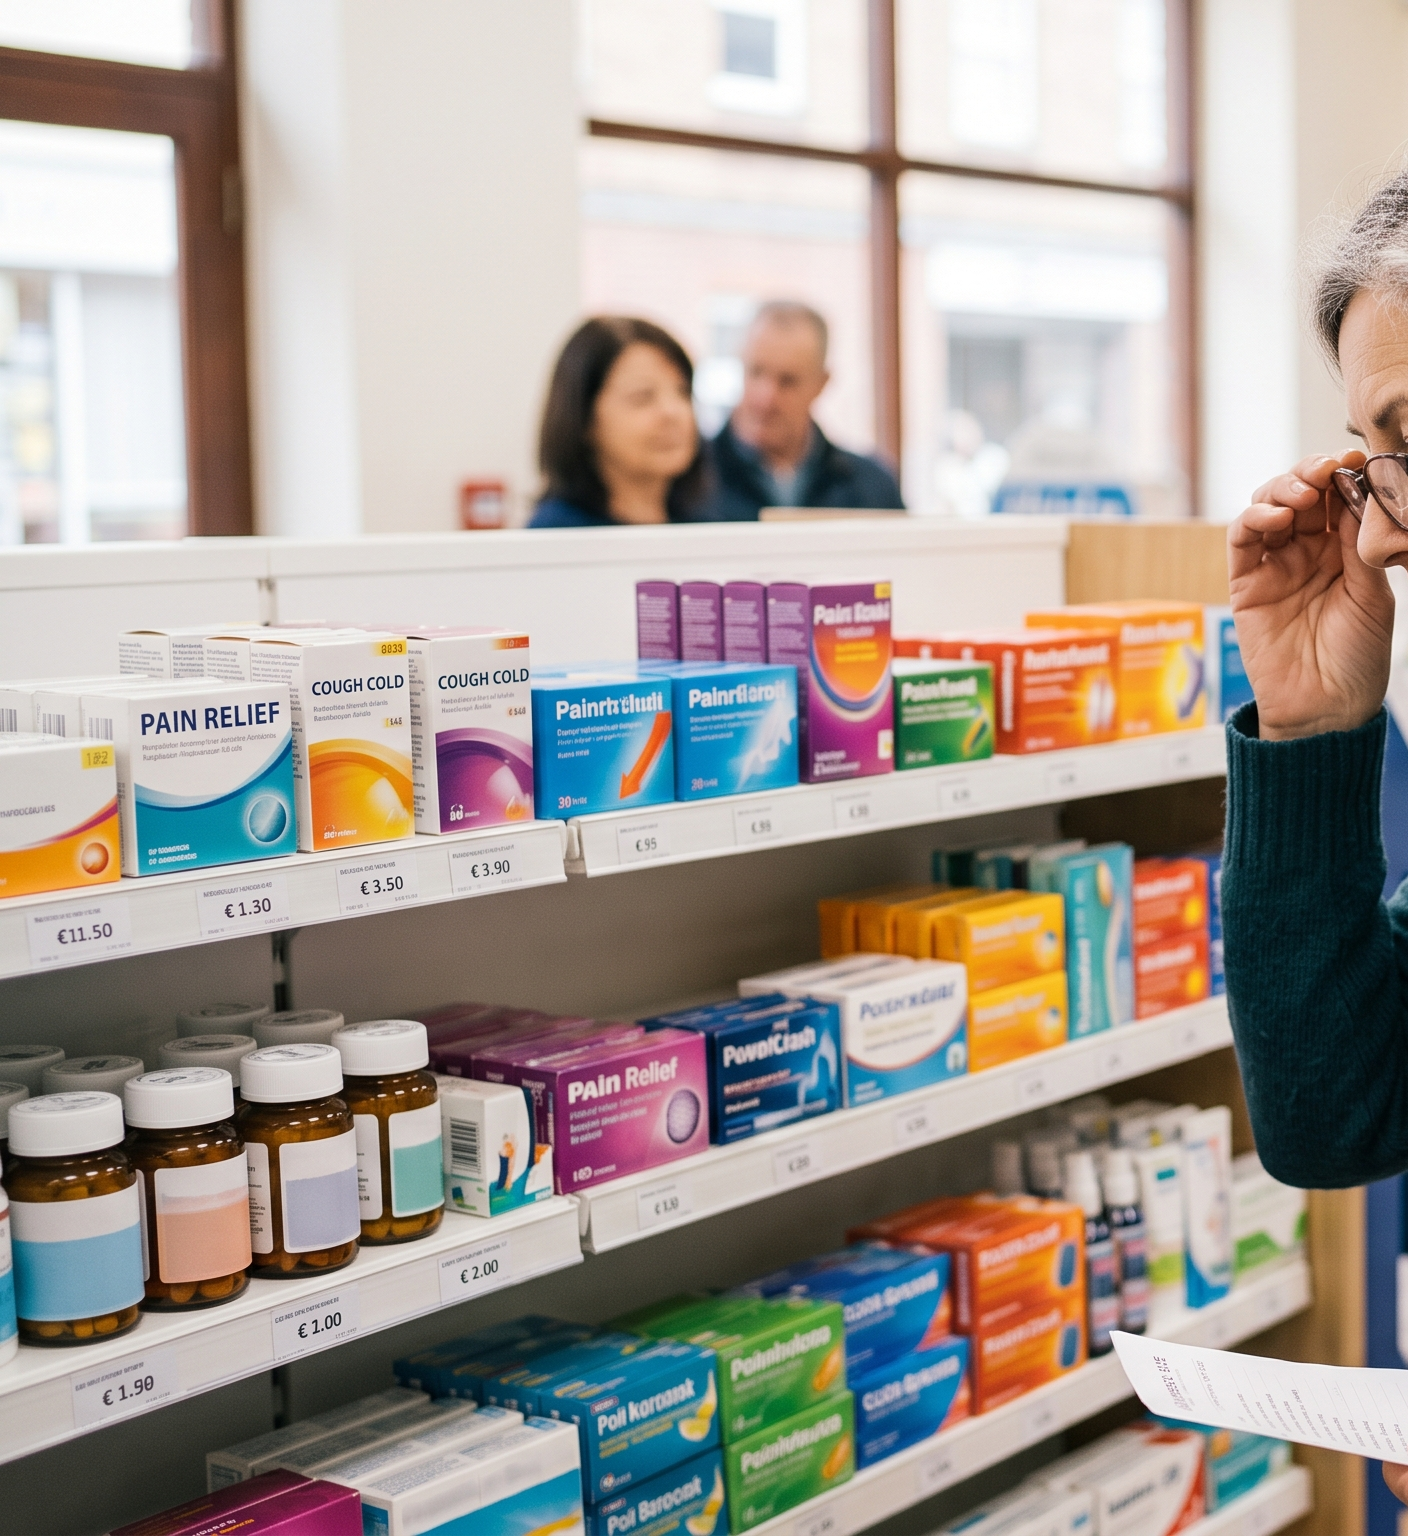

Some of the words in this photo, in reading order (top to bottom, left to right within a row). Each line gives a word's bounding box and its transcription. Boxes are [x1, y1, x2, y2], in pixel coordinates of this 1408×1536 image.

[311, 677, 363, 696] COUGH
[366, 674, 404, 691] COLD
[438, 671, 489, 690] COUGH
[492, 668, 530, 685] COLD
[140, 708, 198, 736] PAIN
[204, 701, 280, 730] RELIEF
[471, 864, 481, 878] €
[482, 859, 511, 877] 3.90
[360, 881, 371, 896] €
[373, 875, 405, 894] 3.50
[224, 903, 235, 918] €
[238, 897, 272, 917] 1.30
[57, 922, 114, 945] €11.50
[625, 1056, 679, 1091] Relief
[460, 1269, 470, 1284] €
[471, 1259, 500, 1280] 2.00
[297, 1322, 309, 1339] €
[311, 1311, 343, 1335] 1.00
[102, 1389, 114, 1406] €
[118, 1375, 155, 1401] 1.90
